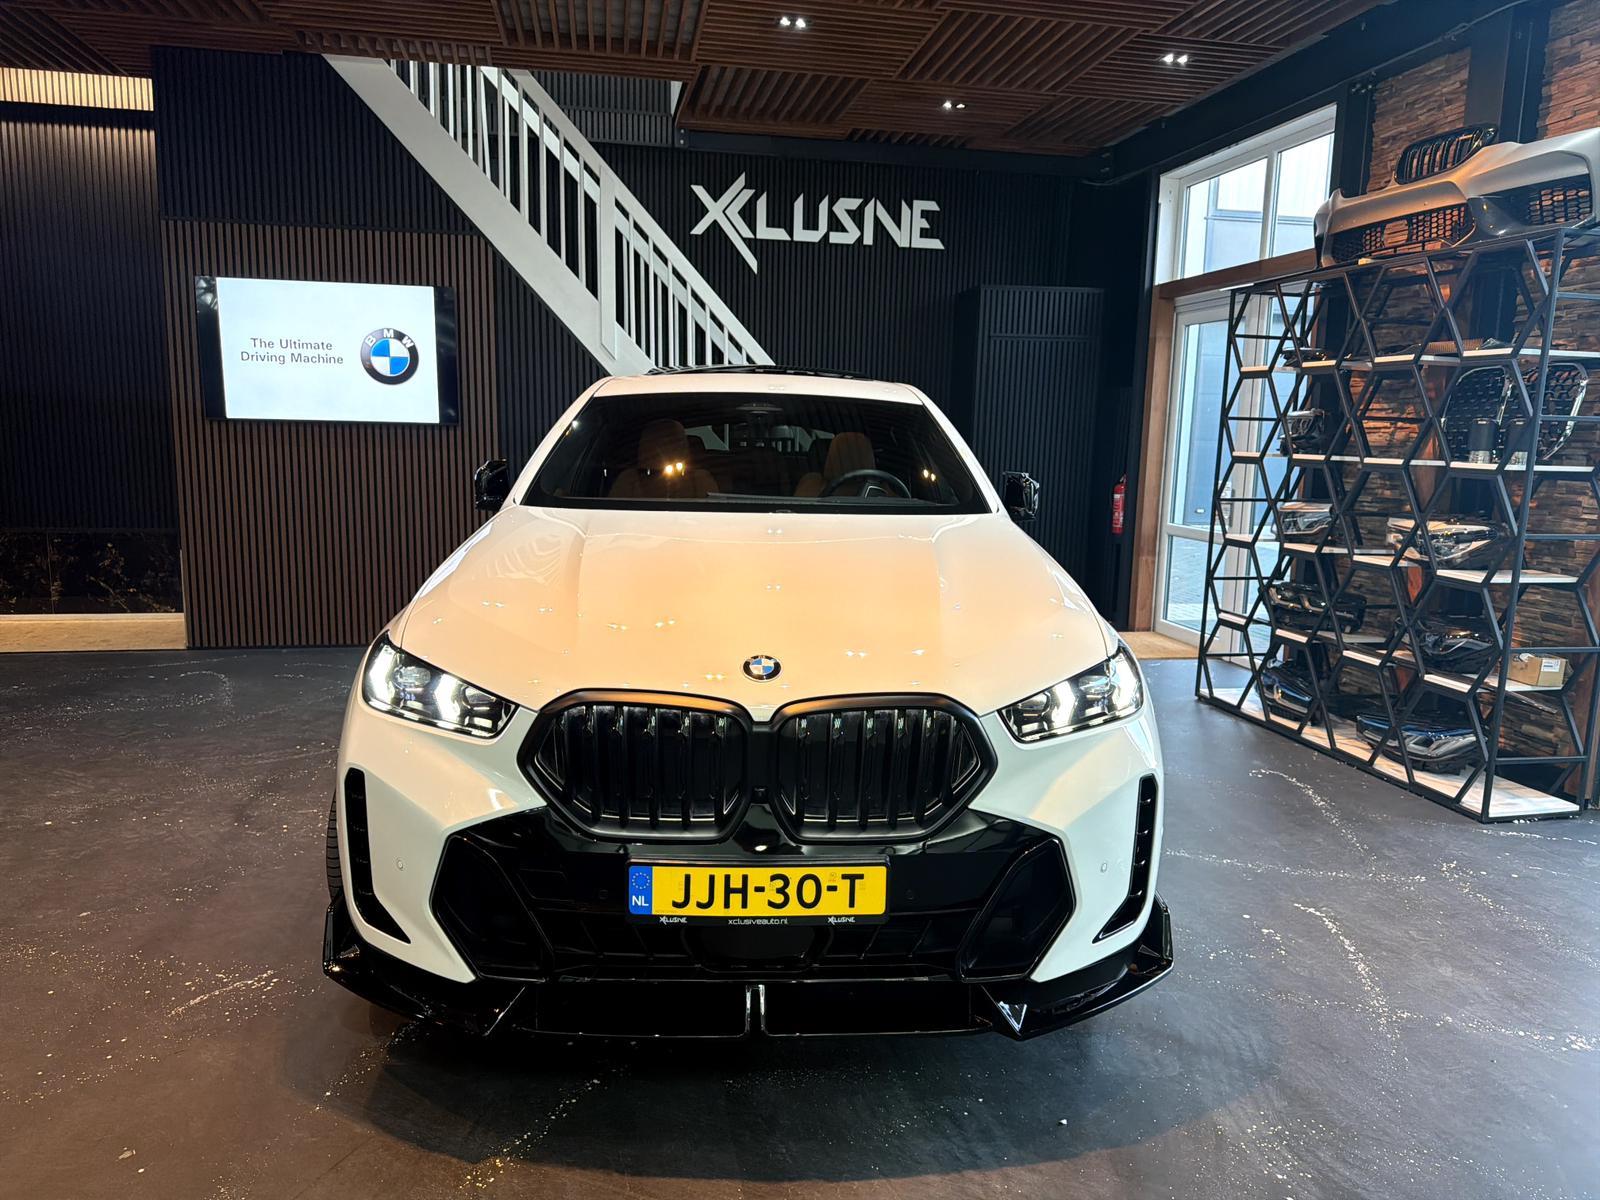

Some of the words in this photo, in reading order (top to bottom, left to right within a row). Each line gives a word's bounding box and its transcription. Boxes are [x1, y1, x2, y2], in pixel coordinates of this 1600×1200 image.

[250, 337, 275, 349] The
[279, 338, 333, 351] Ultimate
[365, 328, 415, 348] BMW
[240, 351, 286, 365] Driving
[290, 353, 344, 365] Machine
[631, 895, 649, 907] NL
[671, 873, 865, 910] JJH-30-T
[727, 917, 789, 926] xclusiveauto.nl
